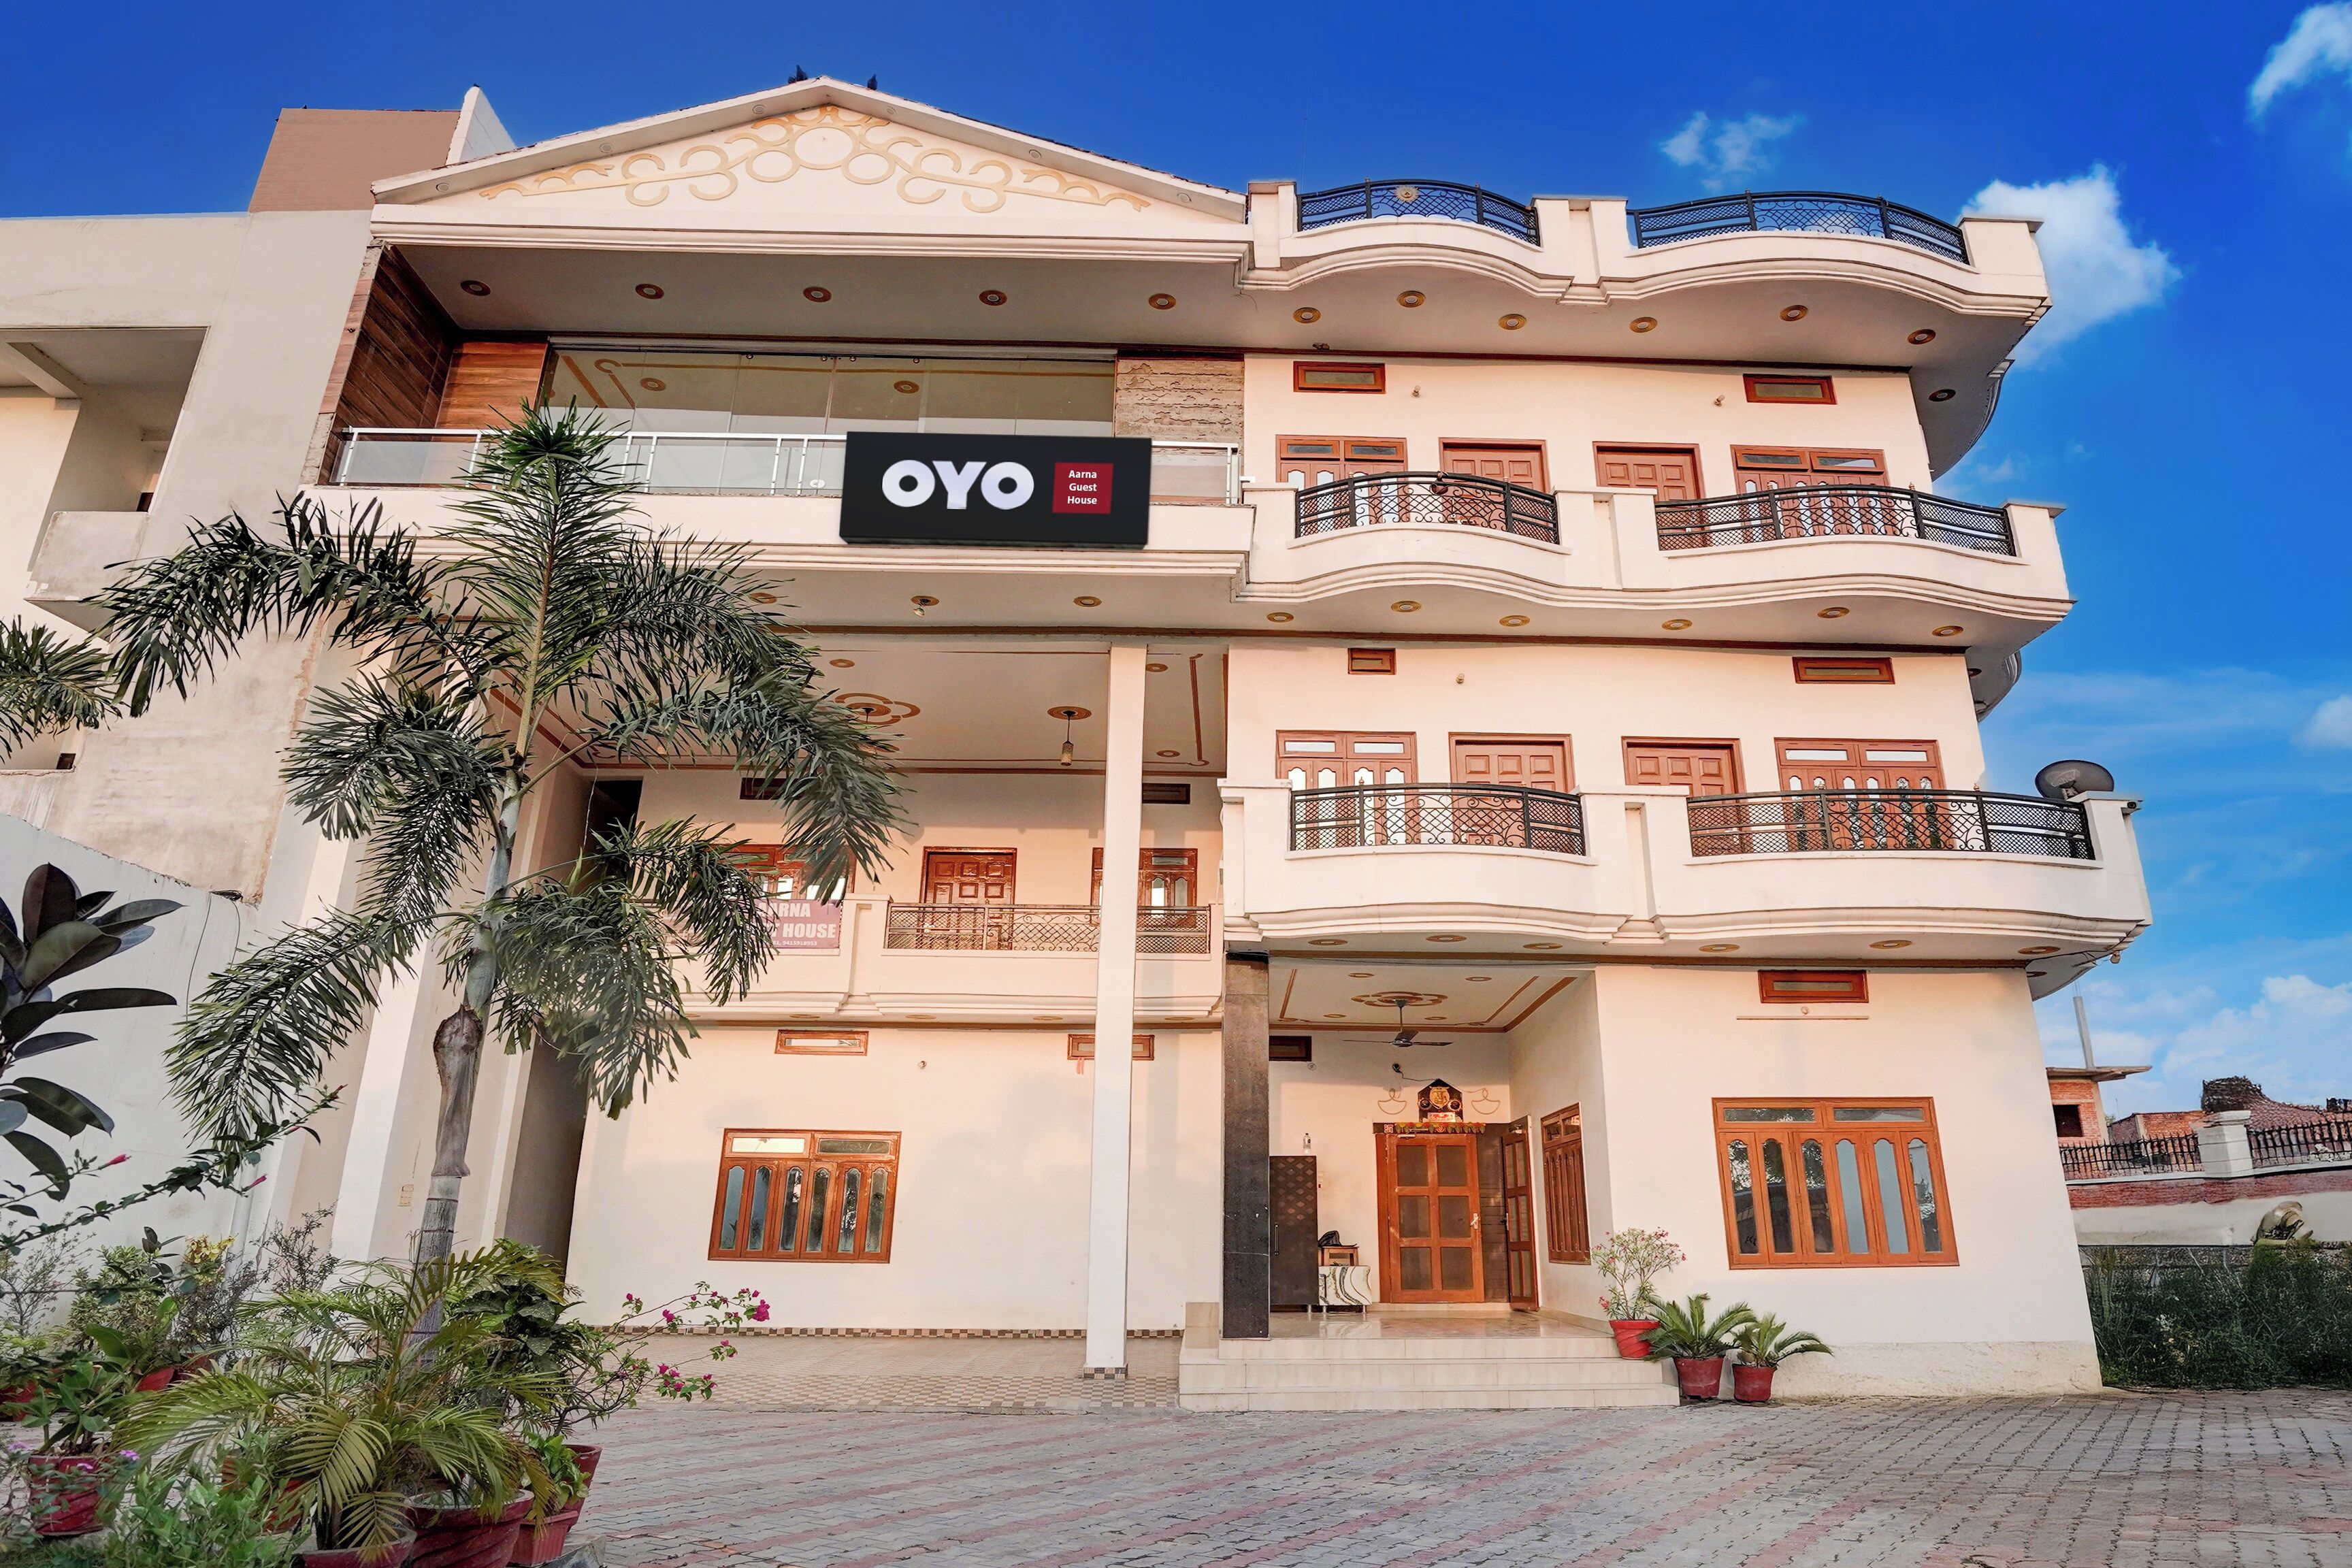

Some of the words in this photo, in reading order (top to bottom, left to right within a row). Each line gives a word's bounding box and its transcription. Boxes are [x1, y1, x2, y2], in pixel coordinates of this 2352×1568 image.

[1068, 470, 1097, 478] Aarna
[882, 459, 1034, 510] OYO
[1068, 483, 1097, 491] Guest
[1067, 495, 1097, 504] House
[783, 923, 836, 938] HOUSE
